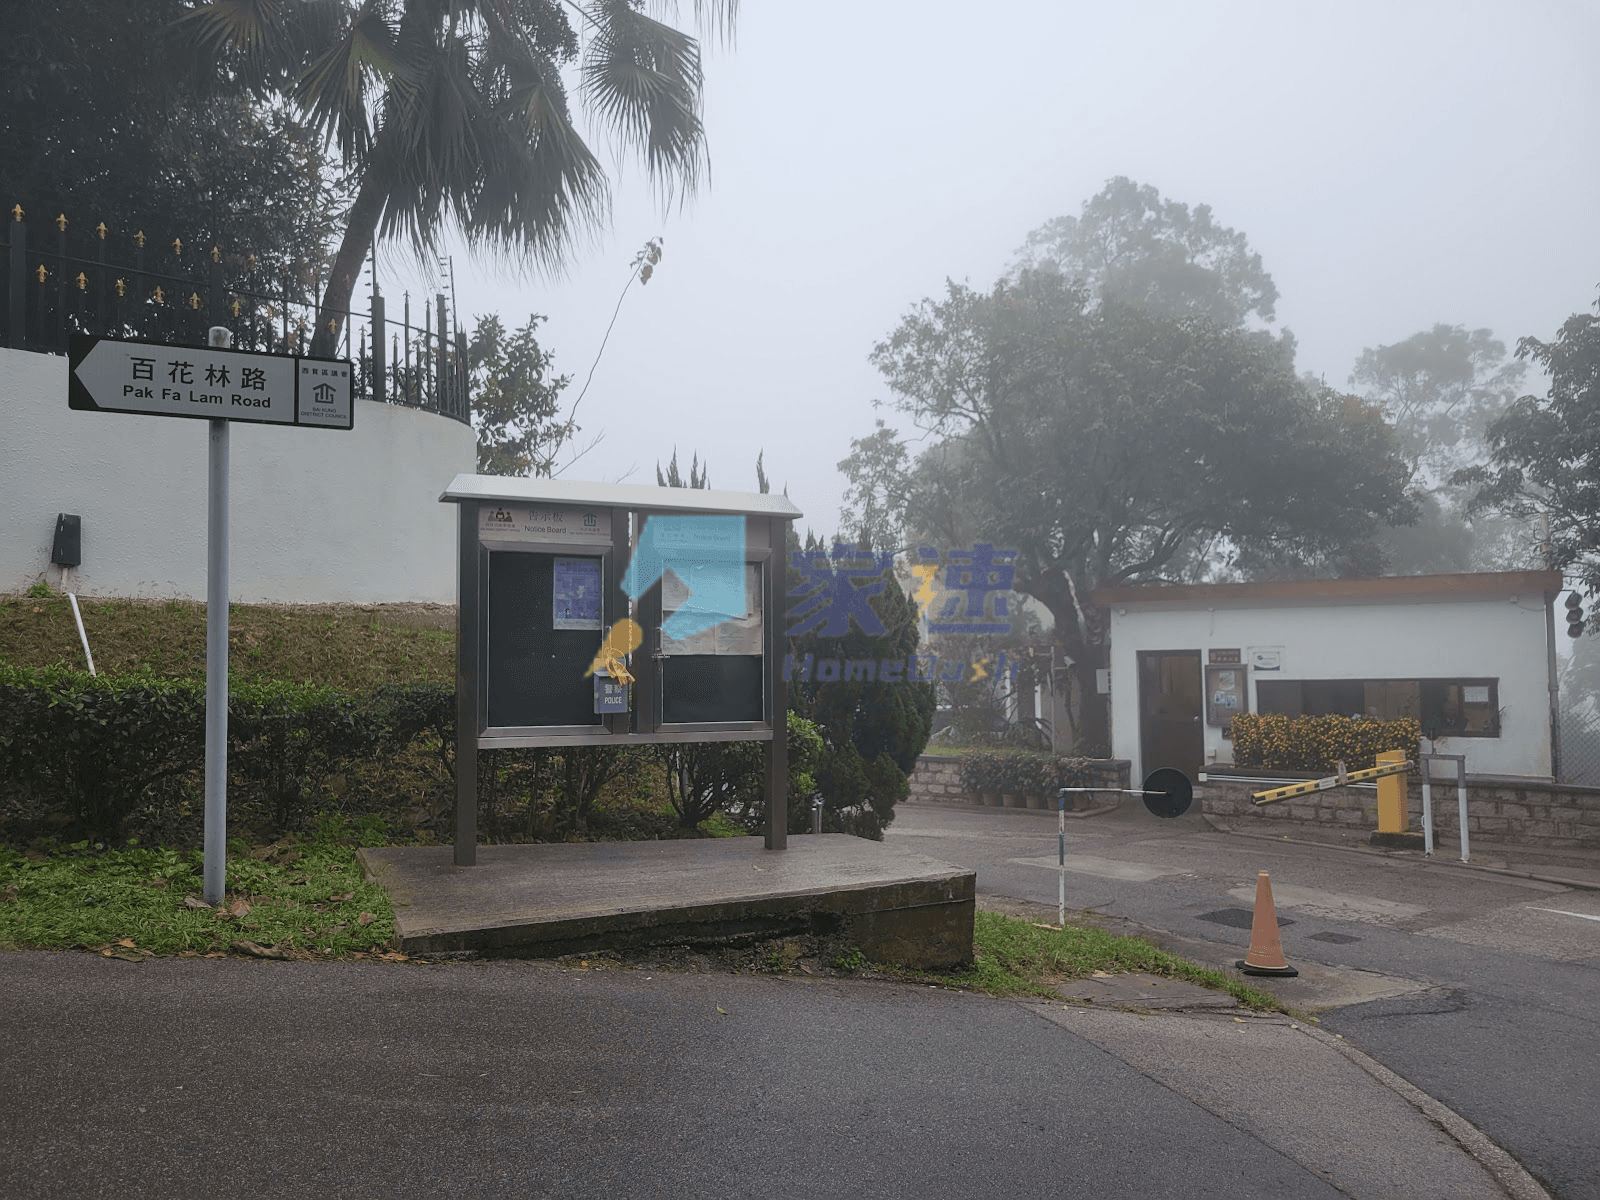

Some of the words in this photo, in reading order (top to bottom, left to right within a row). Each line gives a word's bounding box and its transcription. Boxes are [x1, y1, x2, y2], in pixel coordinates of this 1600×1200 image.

[131, 357, 267, 391] 百花林路
[123, 385, 153, 399] Pak
[162, 388, 181, 401] Fa
[189, 390, 223, 405] Lam
[231, 394, 271, 408] Road
[524, 524, 546, 533] Notice
[546, 525, 567, 534] Board
[604, 696, 623, 705] POLICE
